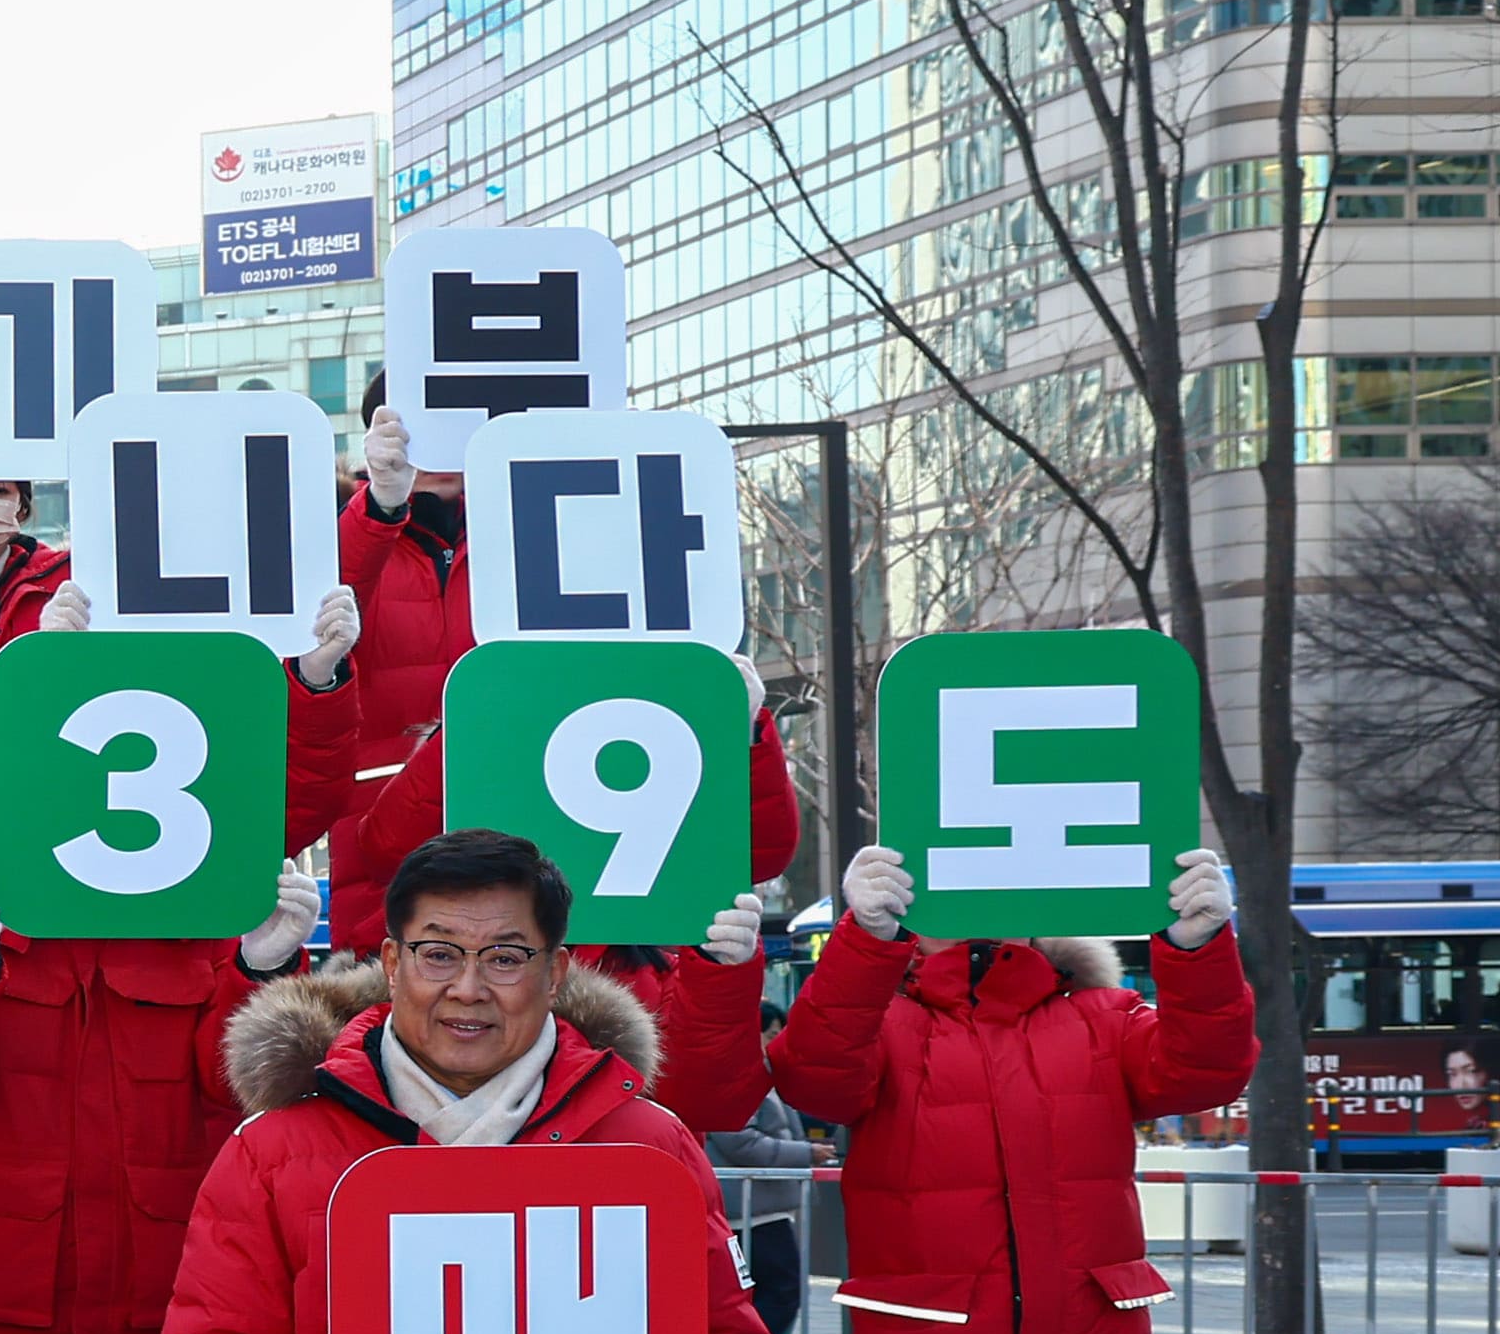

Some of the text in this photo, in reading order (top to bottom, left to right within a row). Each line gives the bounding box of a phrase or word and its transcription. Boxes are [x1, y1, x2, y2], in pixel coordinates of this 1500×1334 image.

[252, 149, 366, 175] 캐나다문화어학원
[218, 215, 297, 242] ETS 공식
[218, 232, 361, 265] TOEFL 시험센터
[424, 270, 589, 418] 부
[112, 434, 294, 615] 니
[509, 454, 706, 632] 다
[52, 690, 212, 893] 3
[543, 699, 703, 897] 9
[927, 684, 1150, 891] 도
